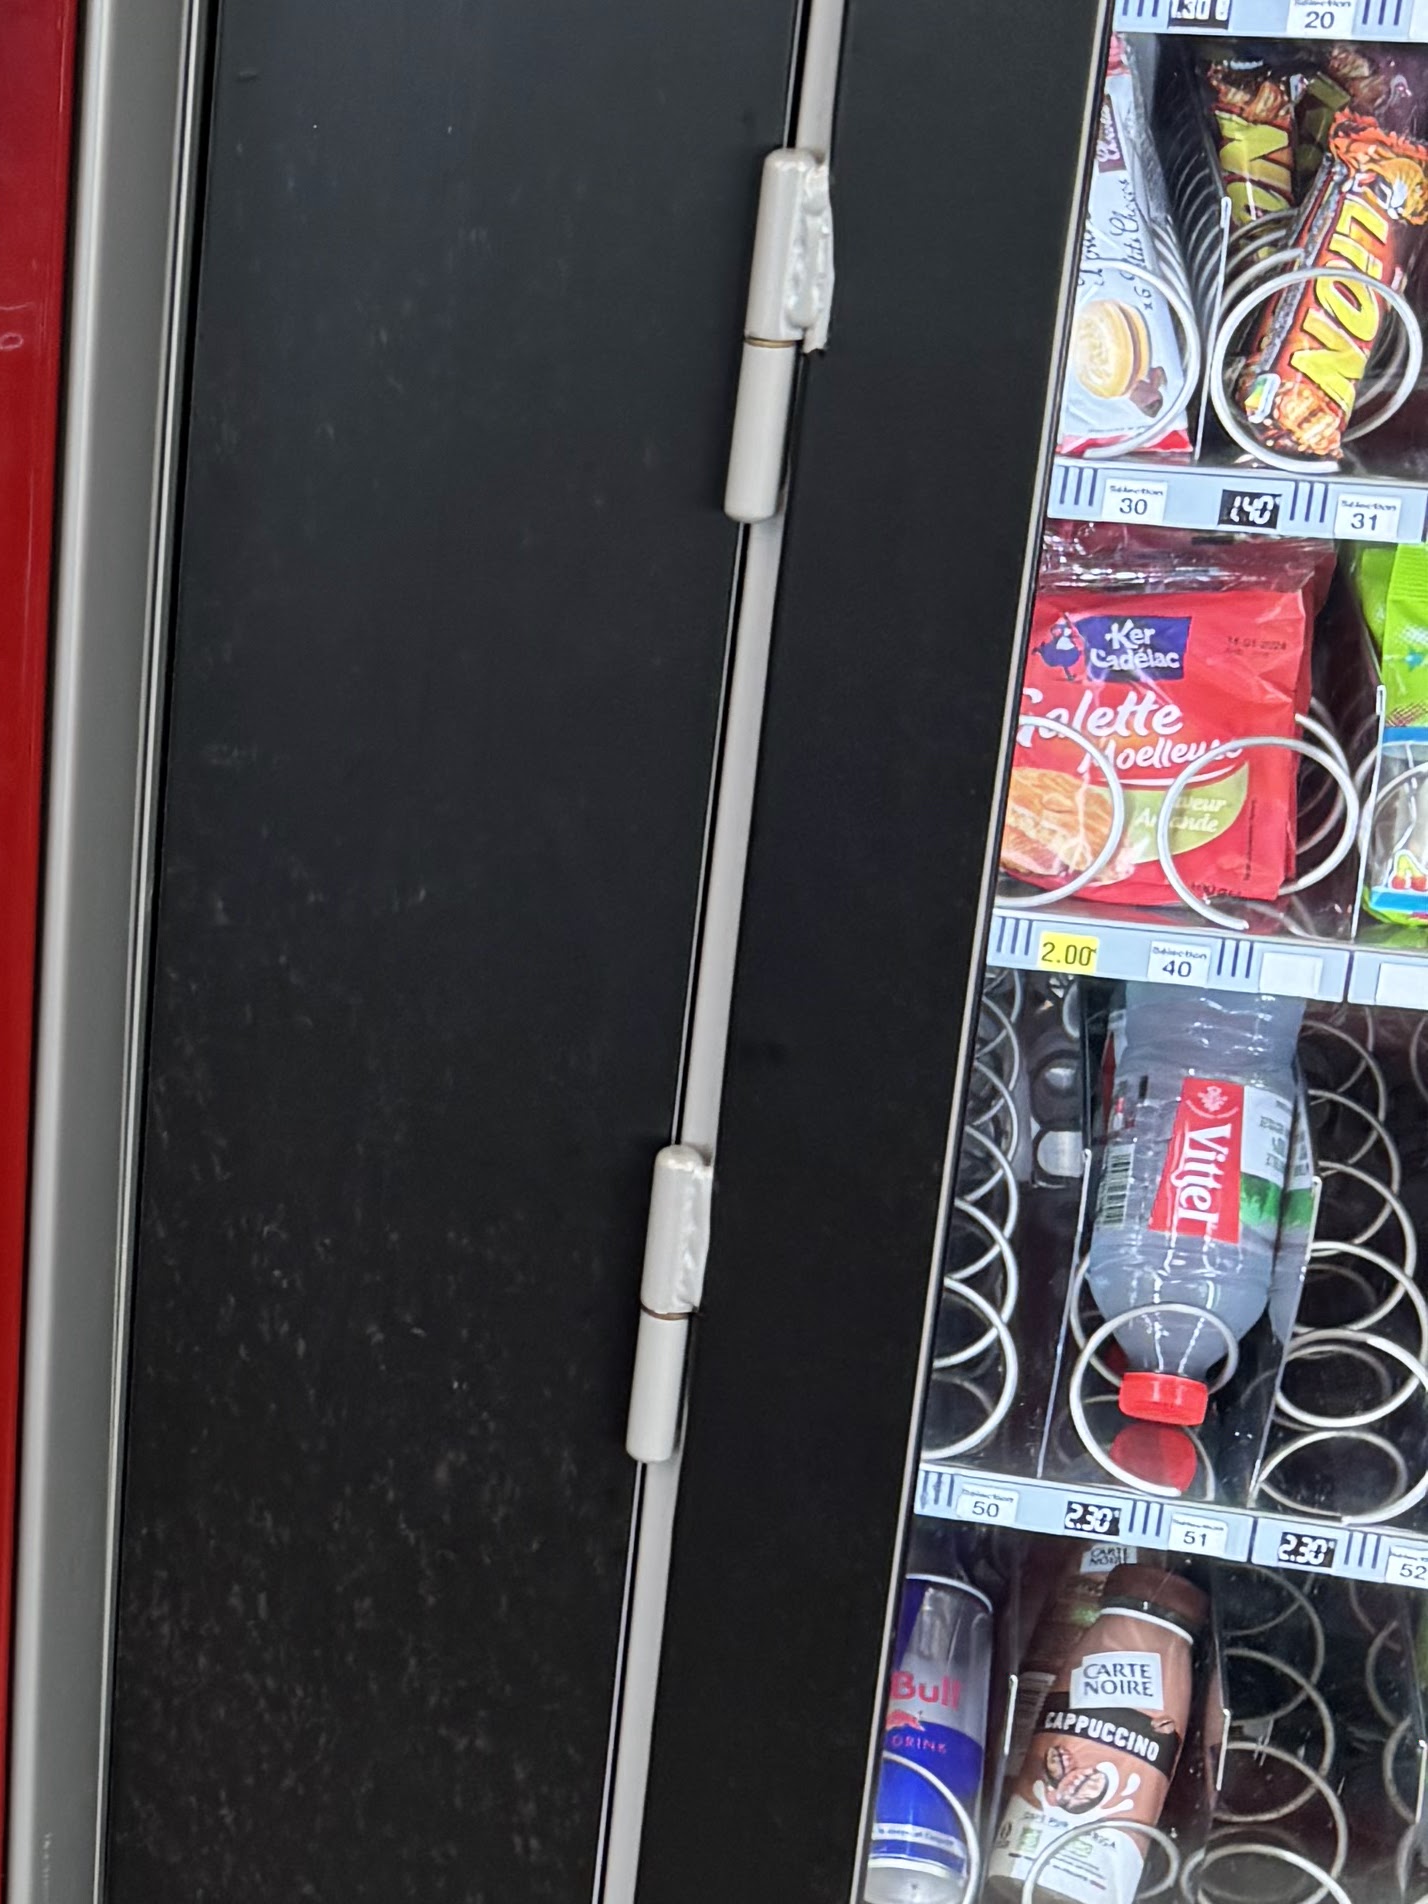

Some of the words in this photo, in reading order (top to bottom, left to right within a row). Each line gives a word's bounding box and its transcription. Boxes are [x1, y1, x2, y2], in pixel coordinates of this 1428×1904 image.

[1303, 11, 1335, 30] 20
[1290, 194, 1390, 413] LION
[1119, 497, 1148, 516] 30
[1350, 512, 1378, 531] 31
[1105, 620, 1156, 649] Ker
[1090, 647, 1180, 673] Cadélac
[1162, 959, 1192, 978] 40
[1170, 1122, 1233, 1225] Vittel
[971, 1501, 1000, 1519] 50
[1183, 1531, 1208, 1547] 51
[1399, 1565, 1428, 1581] 52
[1082, 1662, 1152, 1680] CARTE
[890, 1670, 962, 1711] Bull
[1082, 1677, 1154, 1698] NOIRE
[1045, 1710, 1161, 1763] CAPPUCCINO
